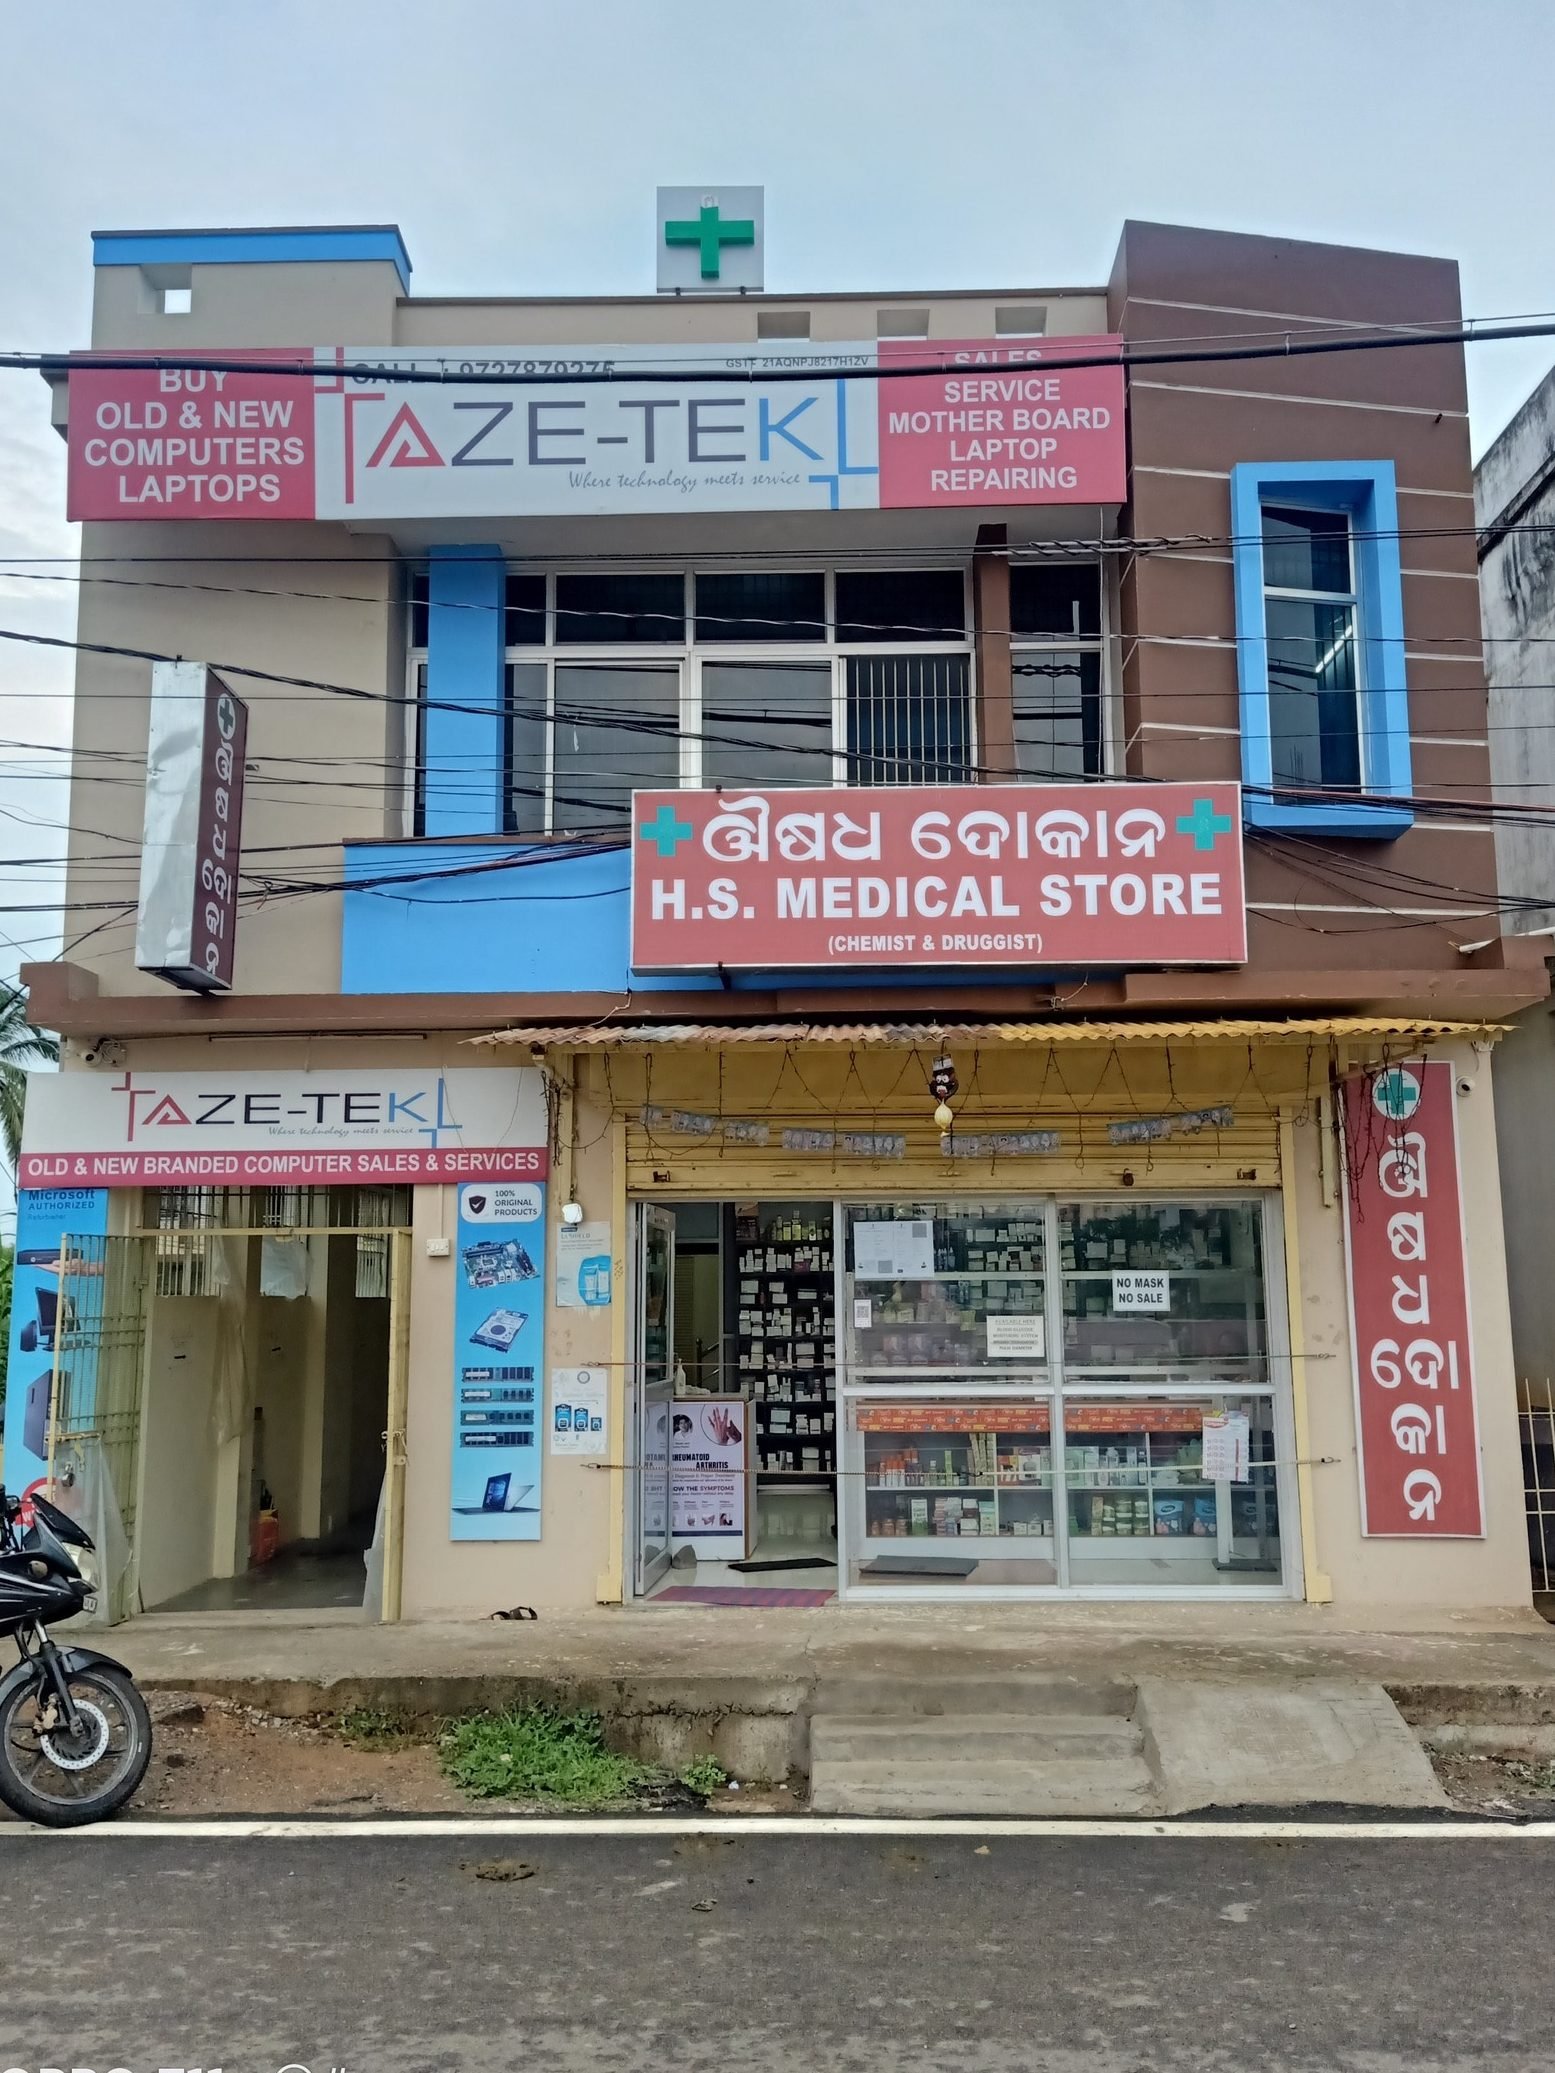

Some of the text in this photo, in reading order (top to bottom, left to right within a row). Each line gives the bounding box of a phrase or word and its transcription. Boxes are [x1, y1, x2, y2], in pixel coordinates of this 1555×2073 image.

[159, 369, 228, 393] BUY
[944, 379, 1060, 404] SERVICE
[96, 400, 294, 430] OLD & NEW
[889, 407, 1110, 434] MOTHER BOARD
[84, 437, 305, 467] COMPUTERS
[950, 438, 1057, 462] LAPTOP
[118, 474, 280, 503] LAPTOPS
[569, 470, 800, 493] Where technology meets service
[930, 466, 1077, 491] REPAIRING
[702, 796, 1165, 863] ଔଷଧ ଦୋକାନ
[651, 873, 1222, 920] H.S. MEDICAL STORE
[827, 934, 1043, 955] (CHEMIST & DRUGGIST)
[268, 1126, 296, 1135] Where
[300, 1126, 349, 1138] technology
[353, 1127, 379, 1135] meets
[28, 1151, 540, 1176] OLD & NEW BRANDED COMPUTER SALES & SERVICES
[28, 1190, 95, 1200] Microsoft
[28, 1201, 95, 1210] AUTHORIZED
[494, 1199, 533, 1207] ORIGINAL
[494, 1208, 538, 1216] PRODUCTS
[1116, 1278, 1164, 1288] NO MASK
[1119, 1293, 1163, 1303] NO SALE
[696, 1461, 729, 1469] ARTHRITIS
